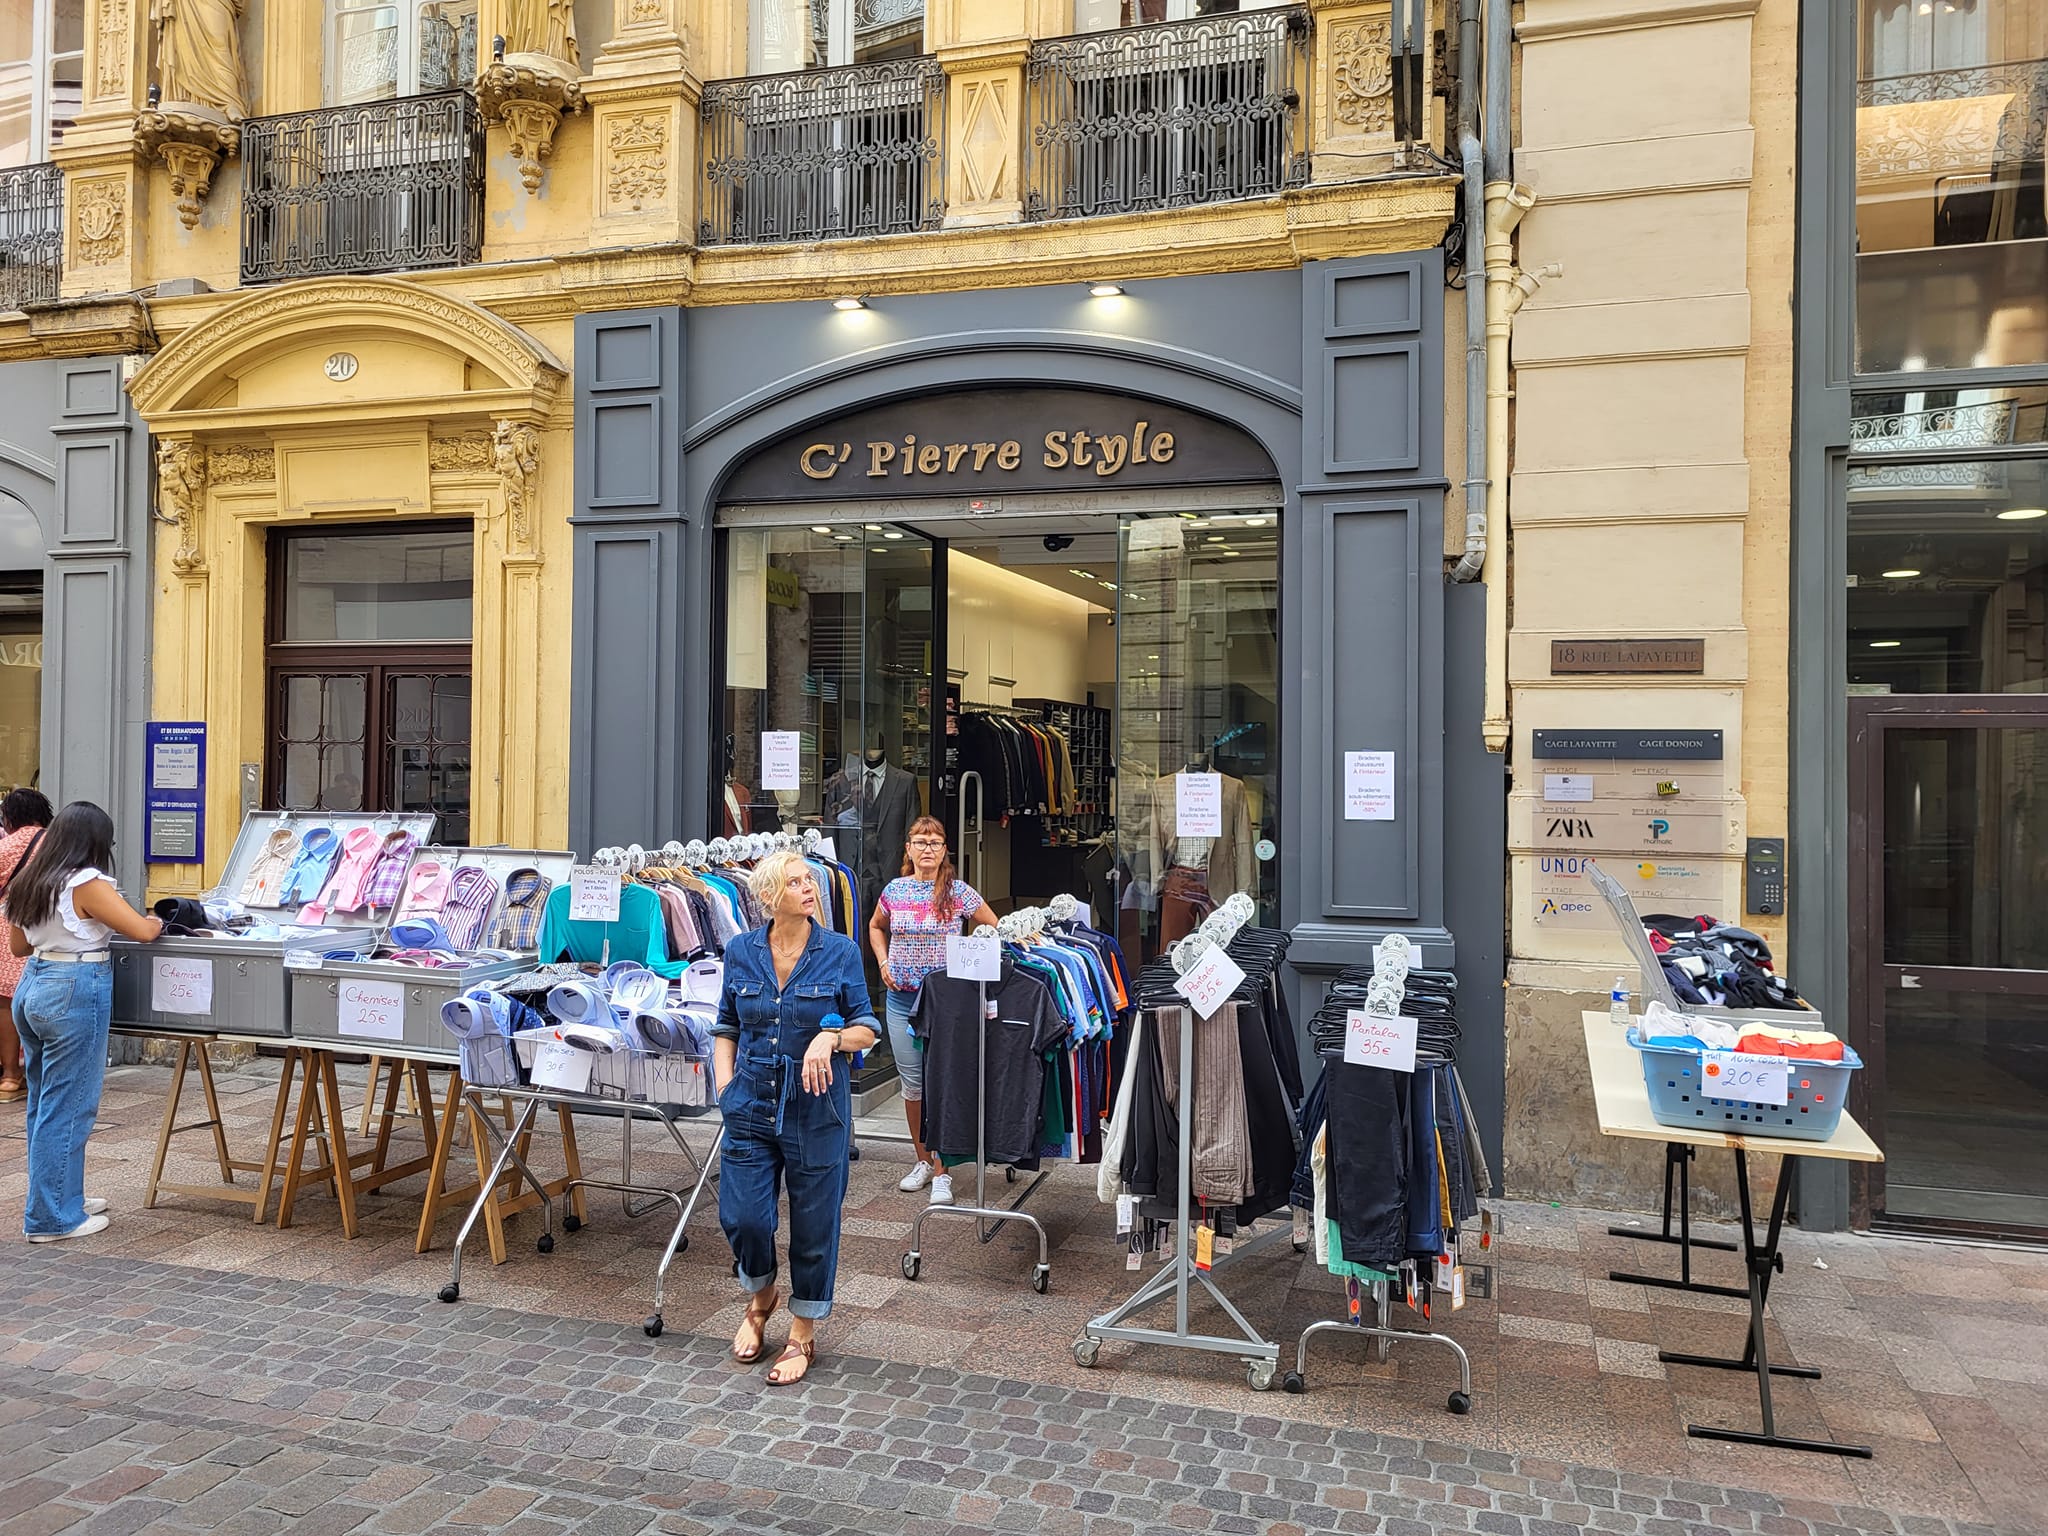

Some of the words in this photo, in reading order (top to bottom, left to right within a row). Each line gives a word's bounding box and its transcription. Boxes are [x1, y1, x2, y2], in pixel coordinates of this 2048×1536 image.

[329, 354, 350, 376] 20
[800, 442, 852, 479] C'
[866, 434, 1021, 477] Pierre
[1043, 421, 1174, 476] Style
[1558, 648, 1575, 664] 18
[1582, 651, 1611, 663] RUE
[1616, 650, 1699, 664] LAFAYETTE
[1544, 740, 1569, 748] CAGE
[1570, 740, 1617, 748] LAFAYETTE
[1639, 740, 1664, 748] CAGE
[1665, 740, 1704, 748] DONJON
[1546, 818, 1594, 838] ZARA
[1561, 903, 1592, 912] apec
[159, 963, 204, 980] Chemises
[1183, 963, 1218, 993] Pantalon
[169, 984, 193, 998] 25€
[345, 986, 400, 1007] Chemises
[357, 1008, 388, 1025] 25€
[1352, 1018, 1400, 1040] Pantalon
[1360, 1039, 1391, 1055] 35€
[654, 1062, 689, 1084] XXL
